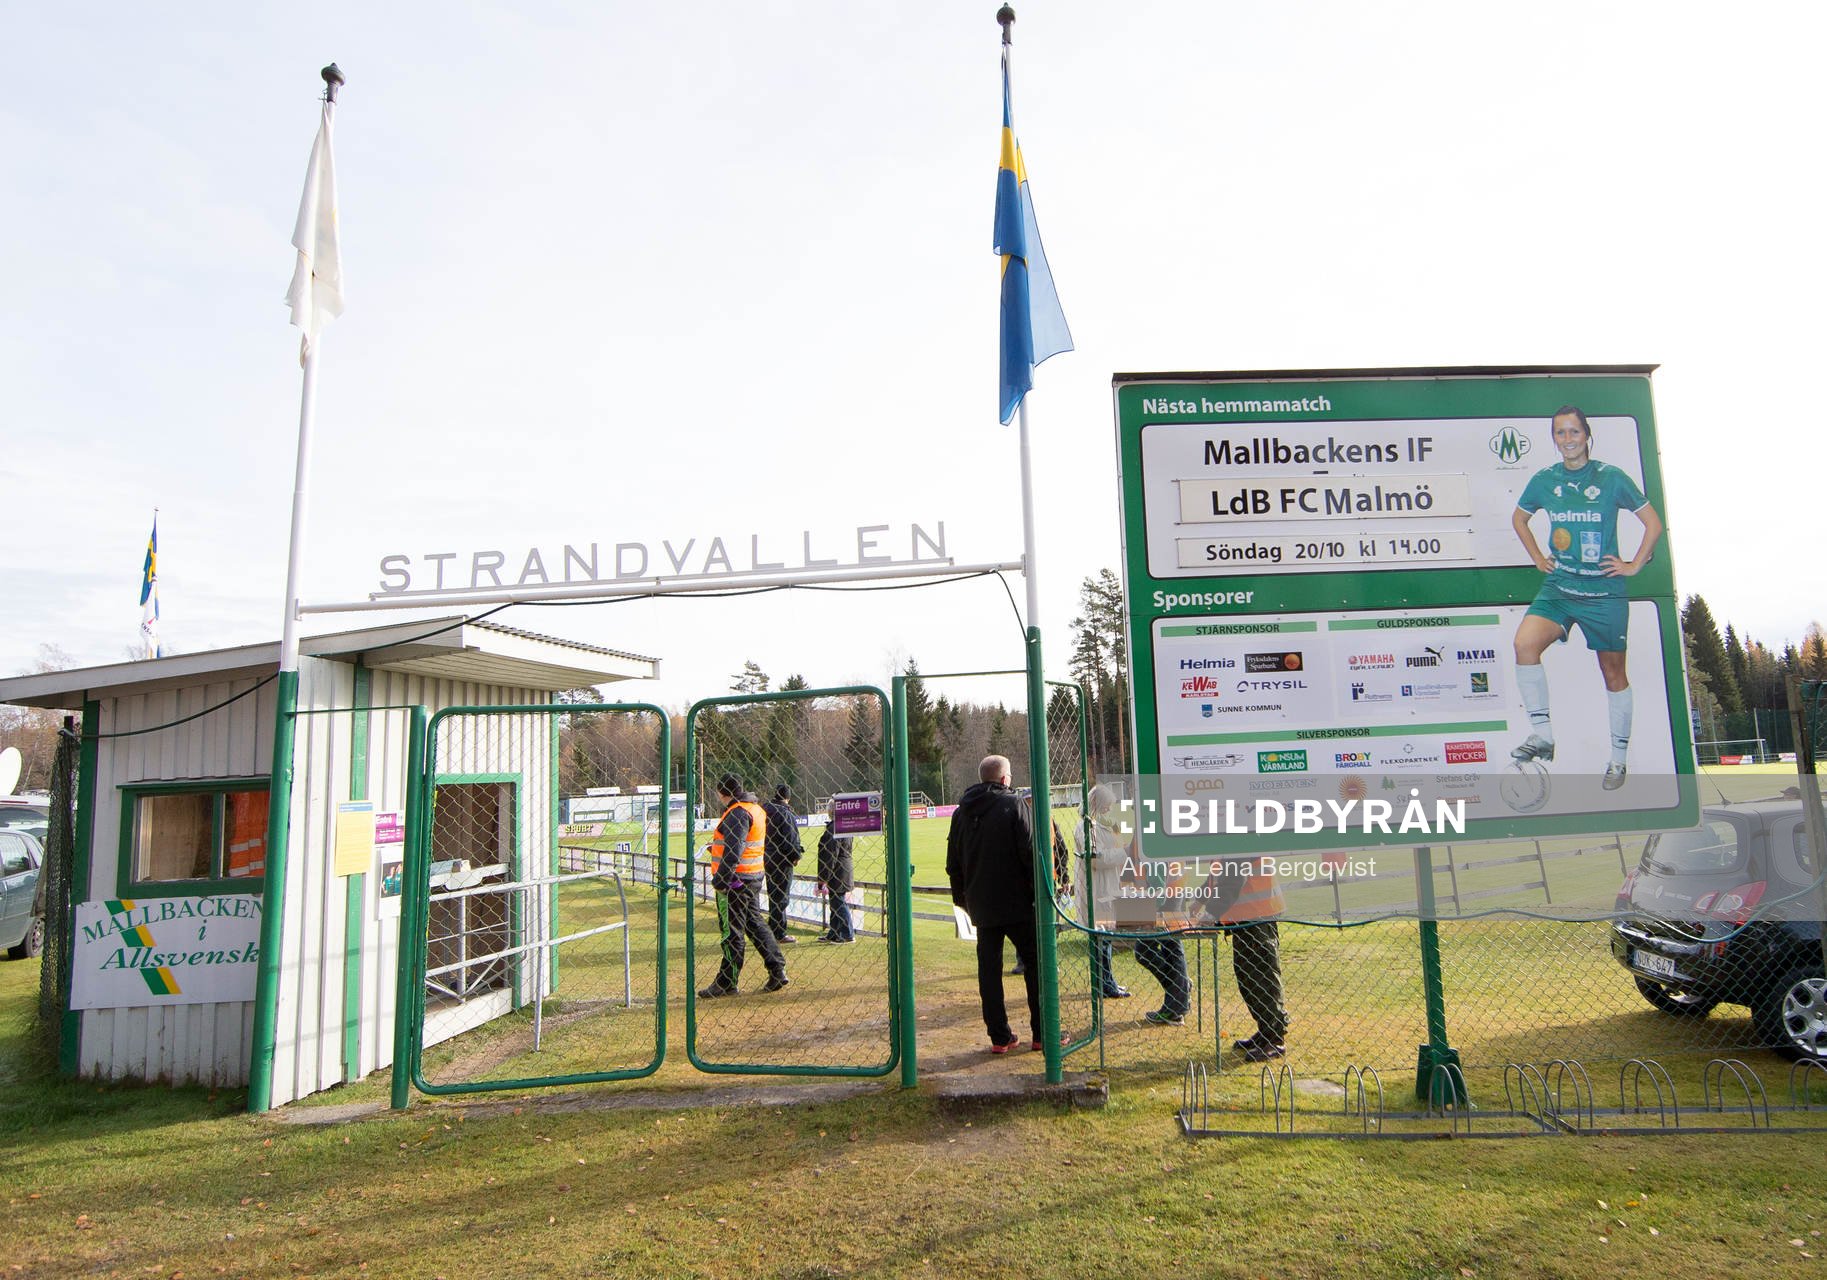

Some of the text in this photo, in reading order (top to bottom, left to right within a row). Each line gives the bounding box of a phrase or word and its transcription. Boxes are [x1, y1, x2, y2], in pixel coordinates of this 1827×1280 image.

[1143, 396, 1332, 414] Nästa hemmamatch
[1204, 437, 1433, 465] Mallbackens IF
[1212, 484, 1433, 515] LdB FC Malmö
[1550, 510, 1602, 523] helmia
[1206, 538, 1441, 562] Söndag 20/10 kl 14.00
[379, 521, 946, 592] STRANDVALLEN
[1153, 589, 1254, 611] Sponsorer
[1376, 617, 1451, 629] GULDSPONSOR
[1195, 624, 1280, 635] STJÄRNSPONSOR
[1180, 658, 1236, 670] Helmia
[1357, 654, 1395, 664] YAMAHA
[1406, 656, 1437, 667] PUMA
[1251, 680, 1308, 691] TRYSIL
[1217, 704, 1282, 714] SUNNE KOMMUN
[1296, 728, 1370, 740] SILVERSPONSOR
[1335, 752, 1371, 762] BROBY
[1447, 751, 1486, 761] TRYCKERI
[1261, 761, 1306, 771] VÄRMLAND
[835, 800, 861, 810] Entré
[565, 824, 593, 833] SPORT
[197, 919, 207, 941] i
